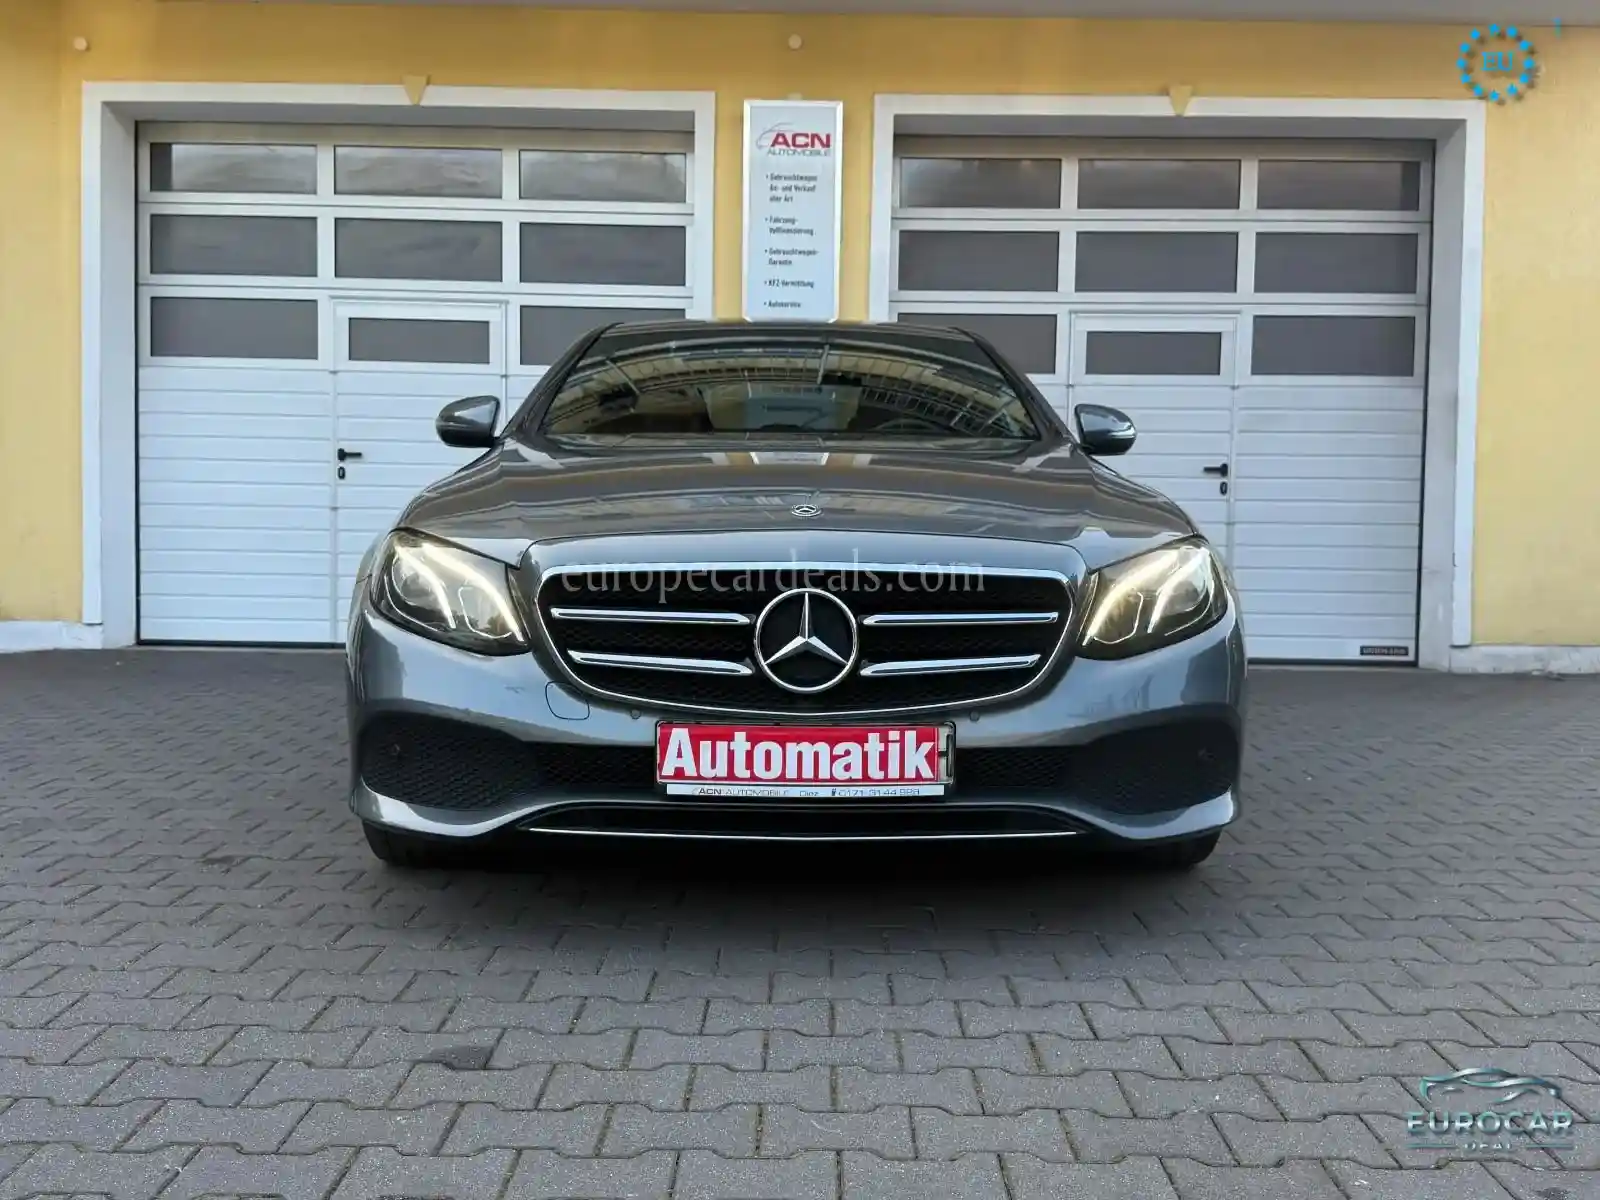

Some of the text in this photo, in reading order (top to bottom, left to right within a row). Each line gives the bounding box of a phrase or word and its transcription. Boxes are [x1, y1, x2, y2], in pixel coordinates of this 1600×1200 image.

[771, 132, 831, 148] ACN
[661, 727, 935, 781] Automatik
[699, 787, 722, 795] ACN
